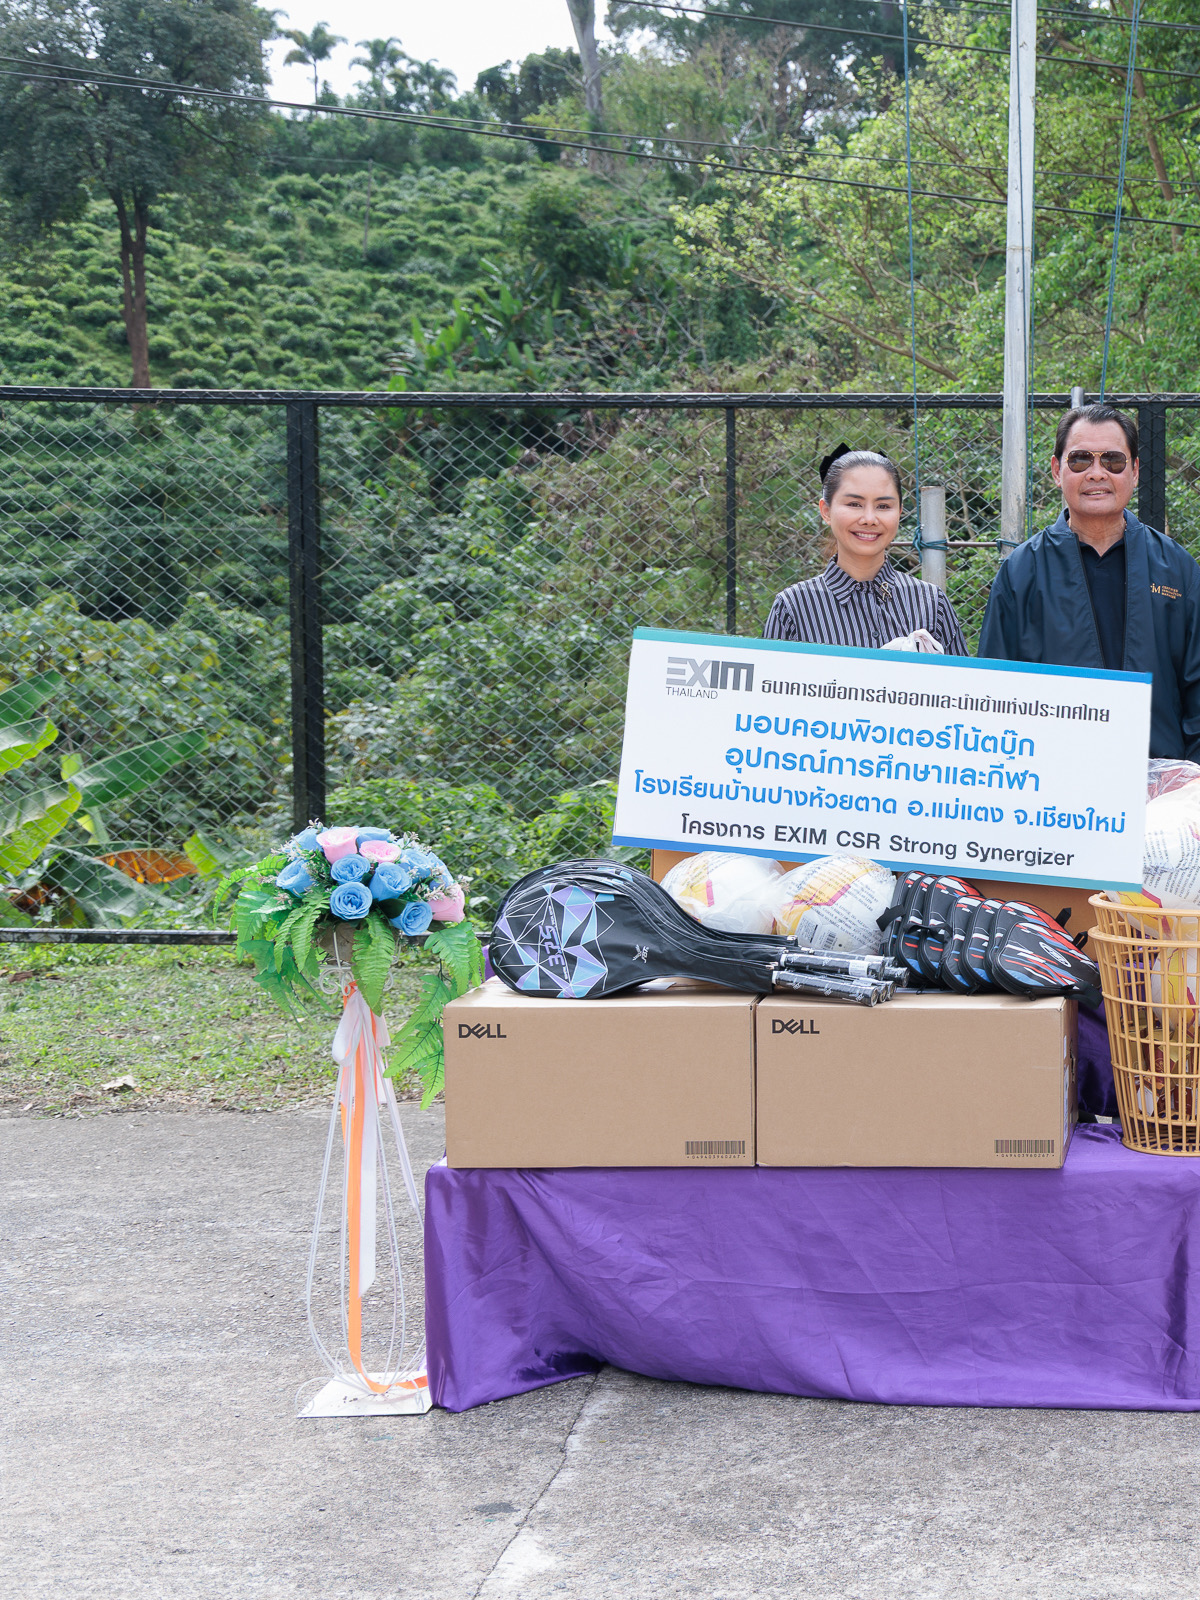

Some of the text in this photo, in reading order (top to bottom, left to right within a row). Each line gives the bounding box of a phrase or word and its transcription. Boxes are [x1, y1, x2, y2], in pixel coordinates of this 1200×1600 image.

[666, 657, 754, 692] EXIM
[666, 687, 718, 699] THAILAND
[762, 679, 1109, 722] ธนาคารเพื่อการส่งออกและนำเข้าแห่งประเทศไทย
[736, 713, 1034, 760] มอบคอมพิวเตอร์โน้ตบุ๊ก
[725, 747, 1039, 791] อุปกรณ์การศึกษาและกีฬา
[635, 769, 1125, 833] โรงเรียนบ้านปางห้วยตาด อ.แม่แตง จ.เชียงใหม่
[682, 813, 1074, 866] โครงการ EXIM CSR Strong Synergizer
[459, 1023, 506, 1039] DELL
[772, 1019, 819, 1034] DELL
